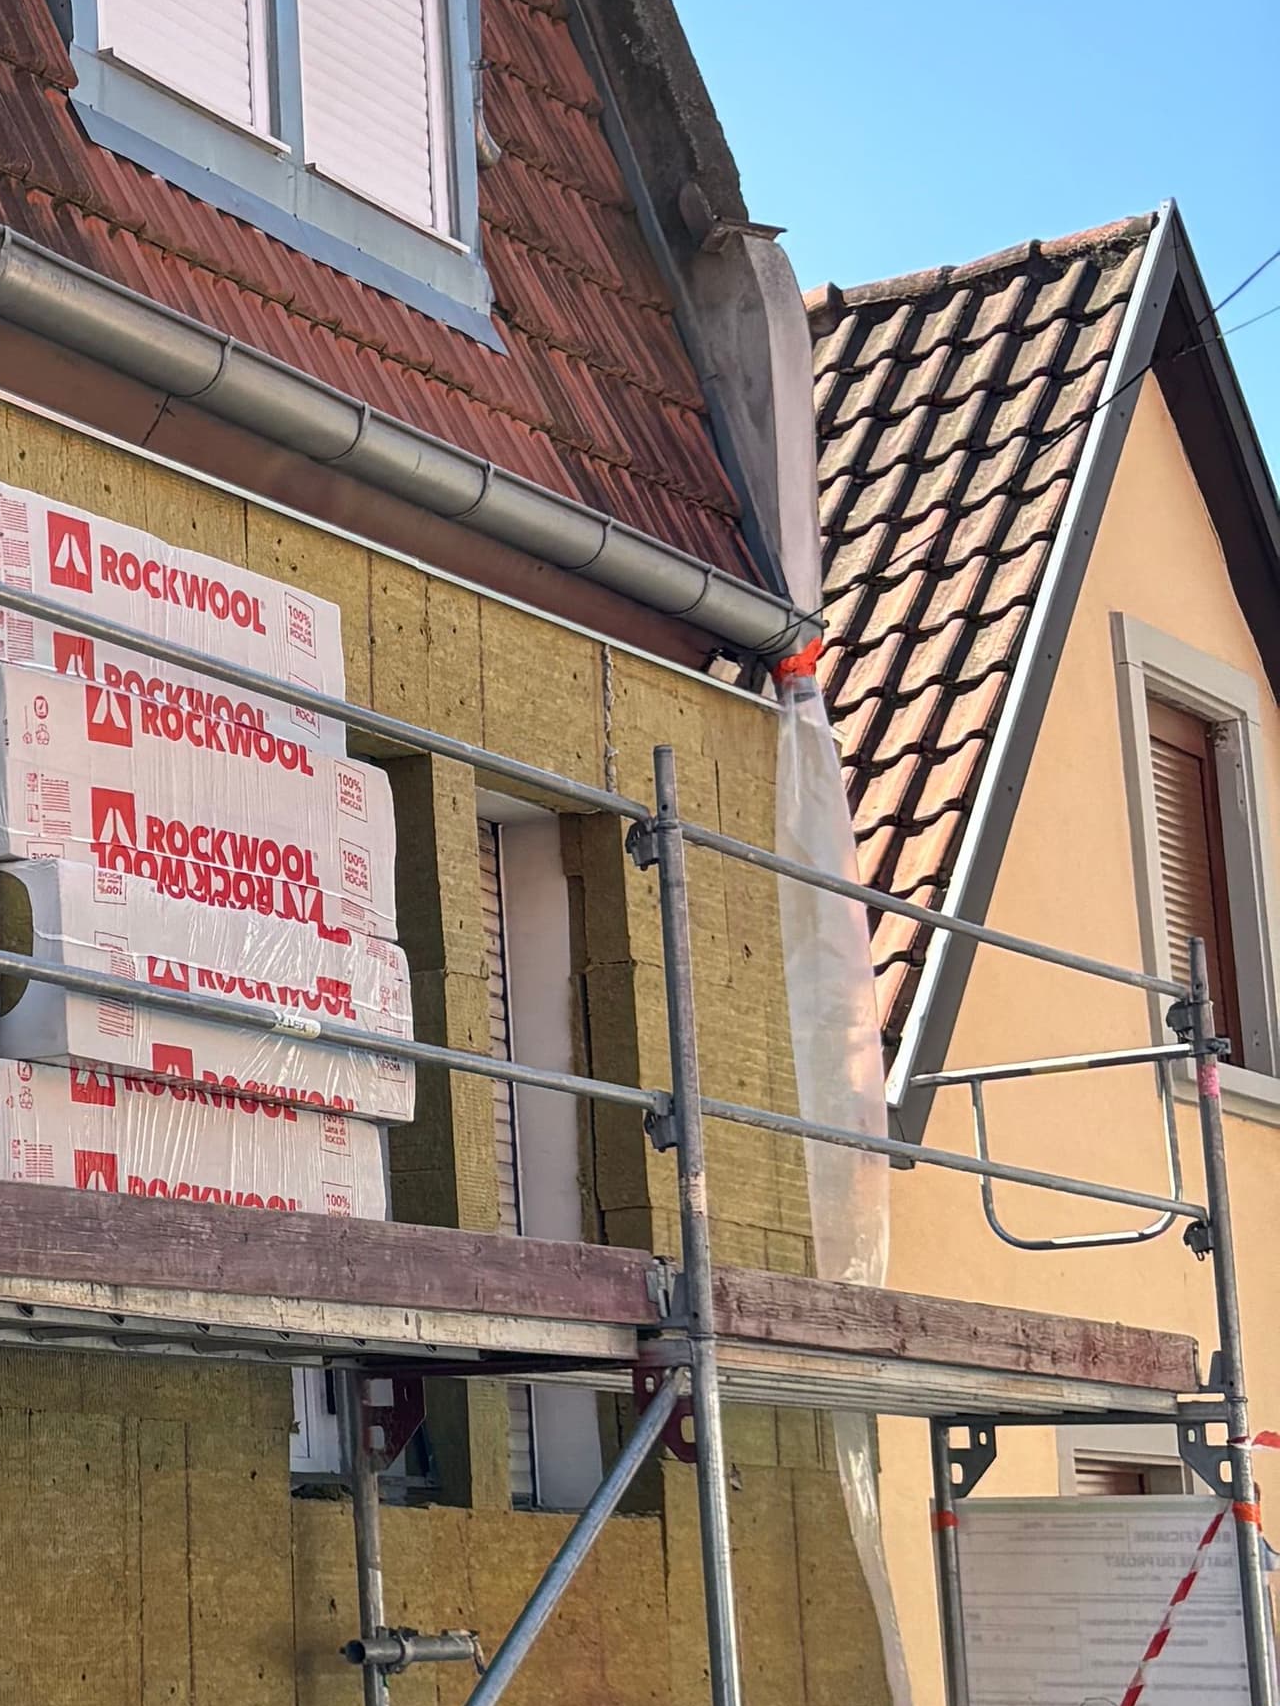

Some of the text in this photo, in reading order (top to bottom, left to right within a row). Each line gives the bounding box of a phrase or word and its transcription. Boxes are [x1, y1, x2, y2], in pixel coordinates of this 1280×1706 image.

[100, 545, 266, 635] ROCKWOOL
[141, 703, 314, 777] ROCKWOOL
[338, 773, 362, 793] 100%
[146, 815, 319, 887] ROCKWOOL
[343, 850, 367, 872] 100%
[325, 1194, 351, 1210] 100%
